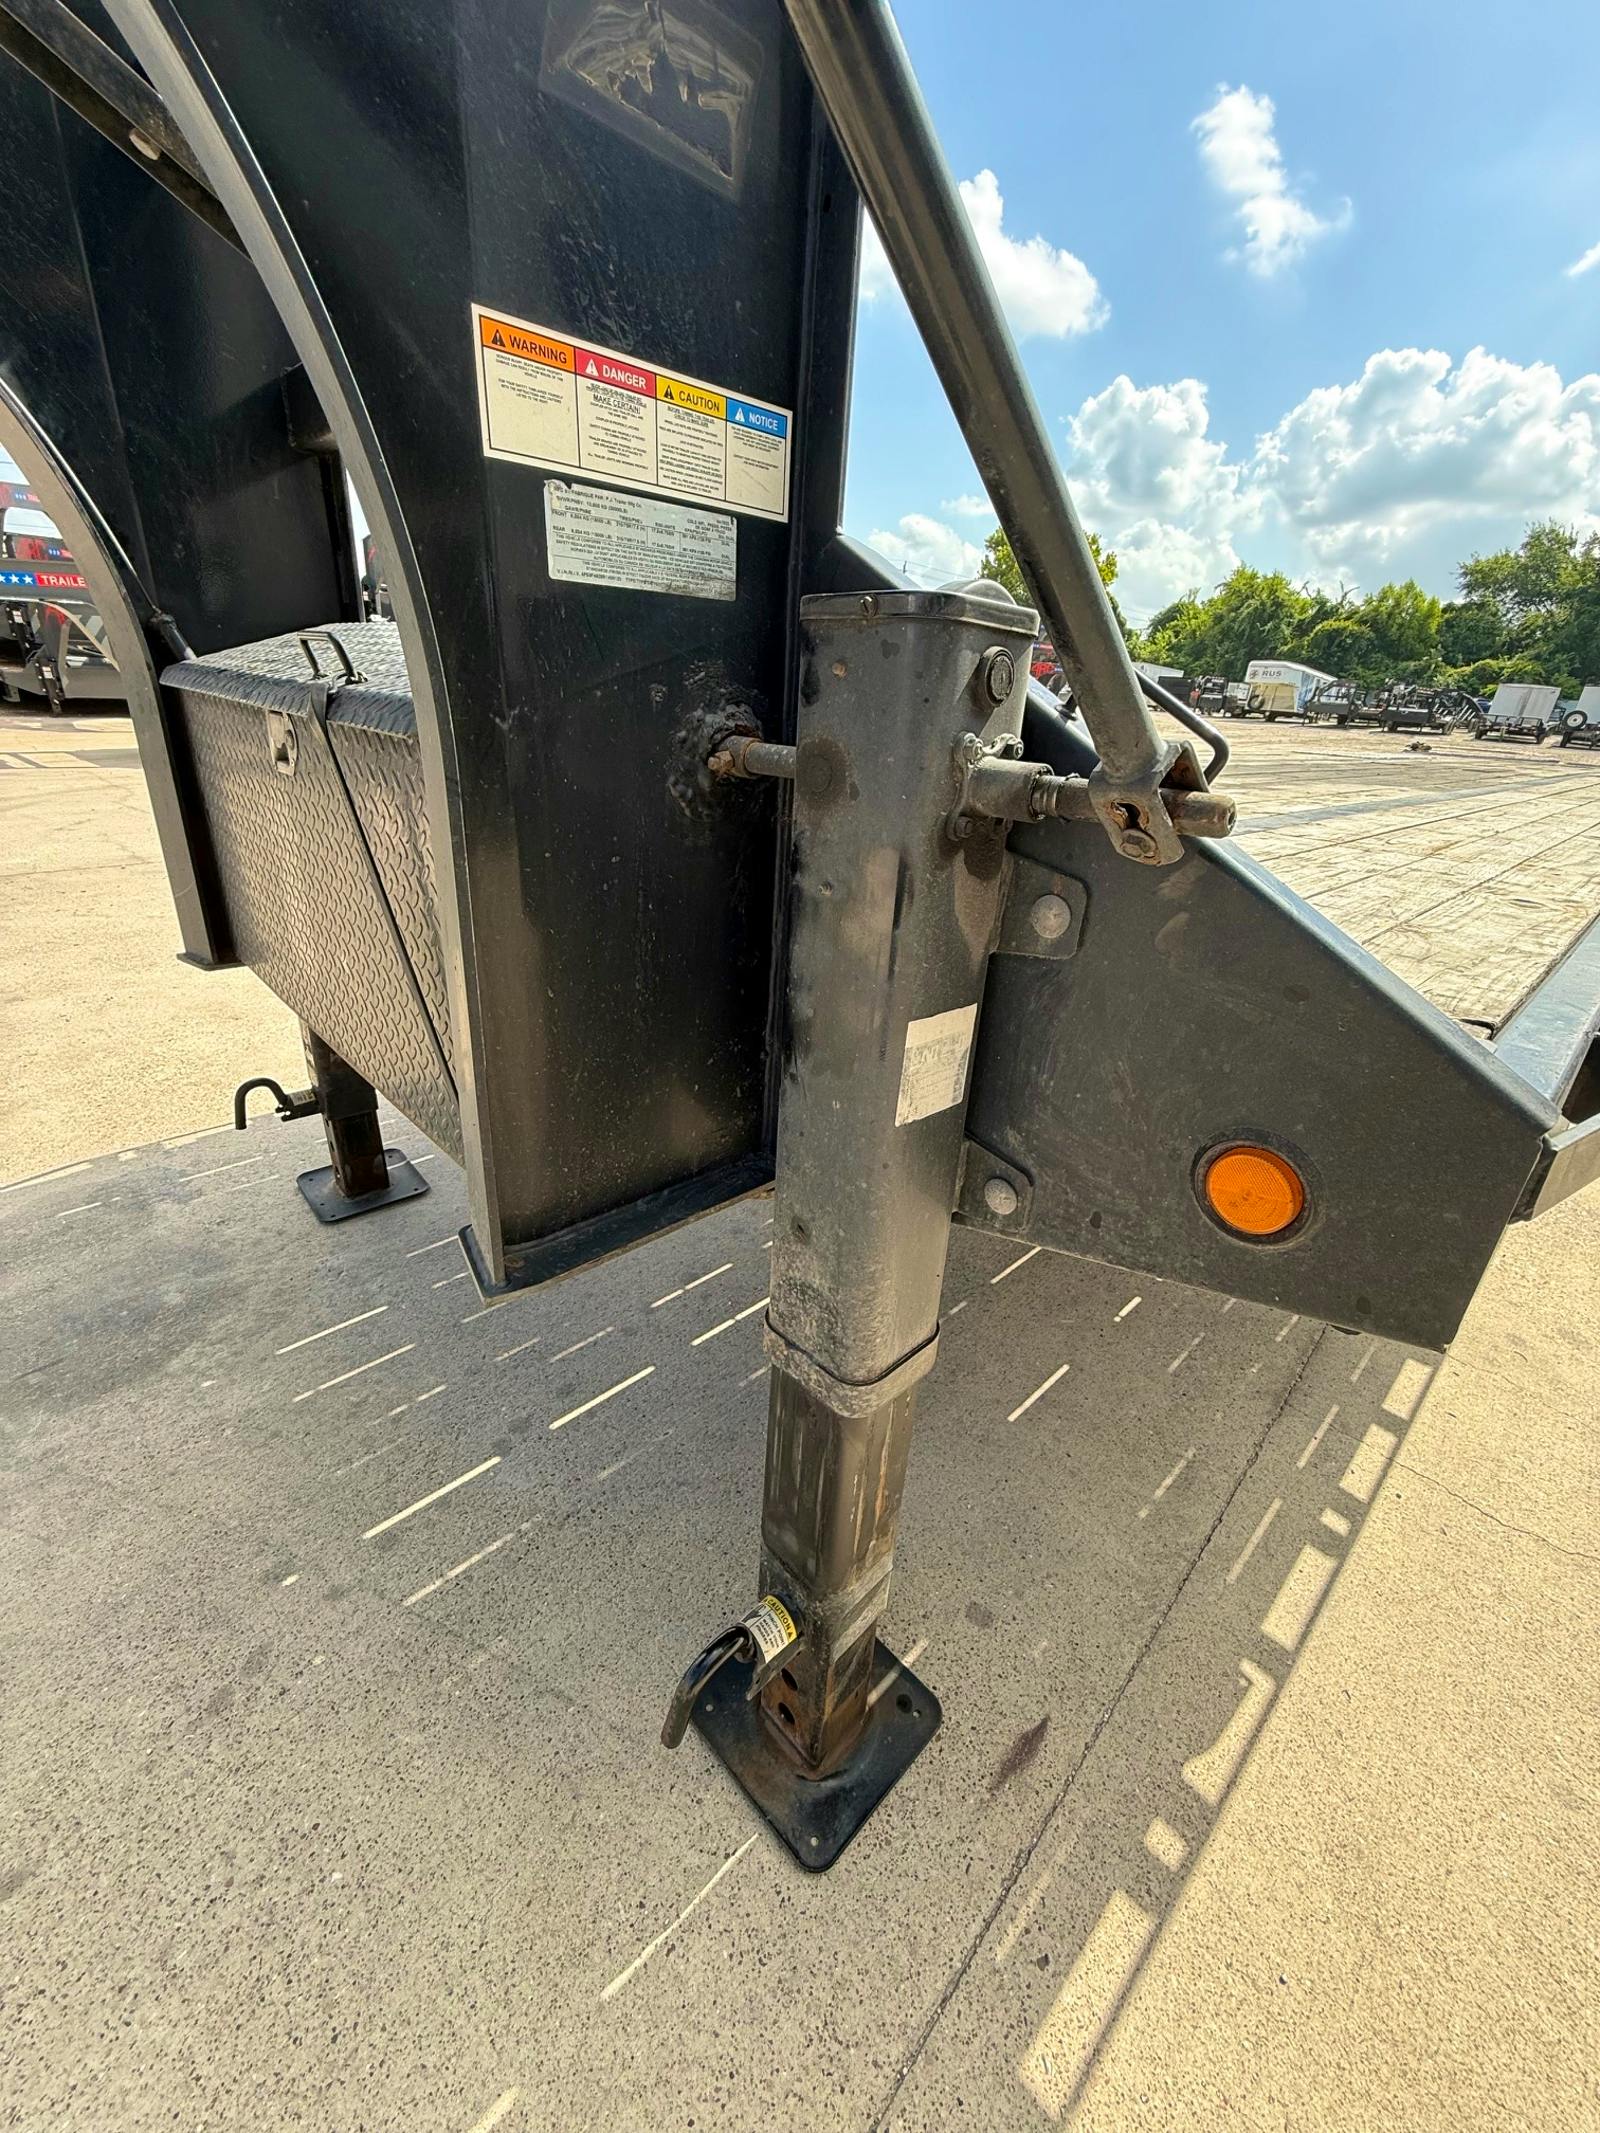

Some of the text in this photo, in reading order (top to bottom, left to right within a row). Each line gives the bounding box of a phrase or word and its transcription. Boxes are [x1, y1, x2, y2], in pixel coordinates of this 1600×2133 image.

[509, 335, 567, 364] WARNING
[602, 364, 646, 390] DANGER
[593, 393, 613, 408] MAKE
[679, 382, 720, 412] CAUTION
[749, 412, 778, 431] NOTICE
[40, 575, 87, 587] TRAILE
[768, 1600, 792, 1630] CAUTION
